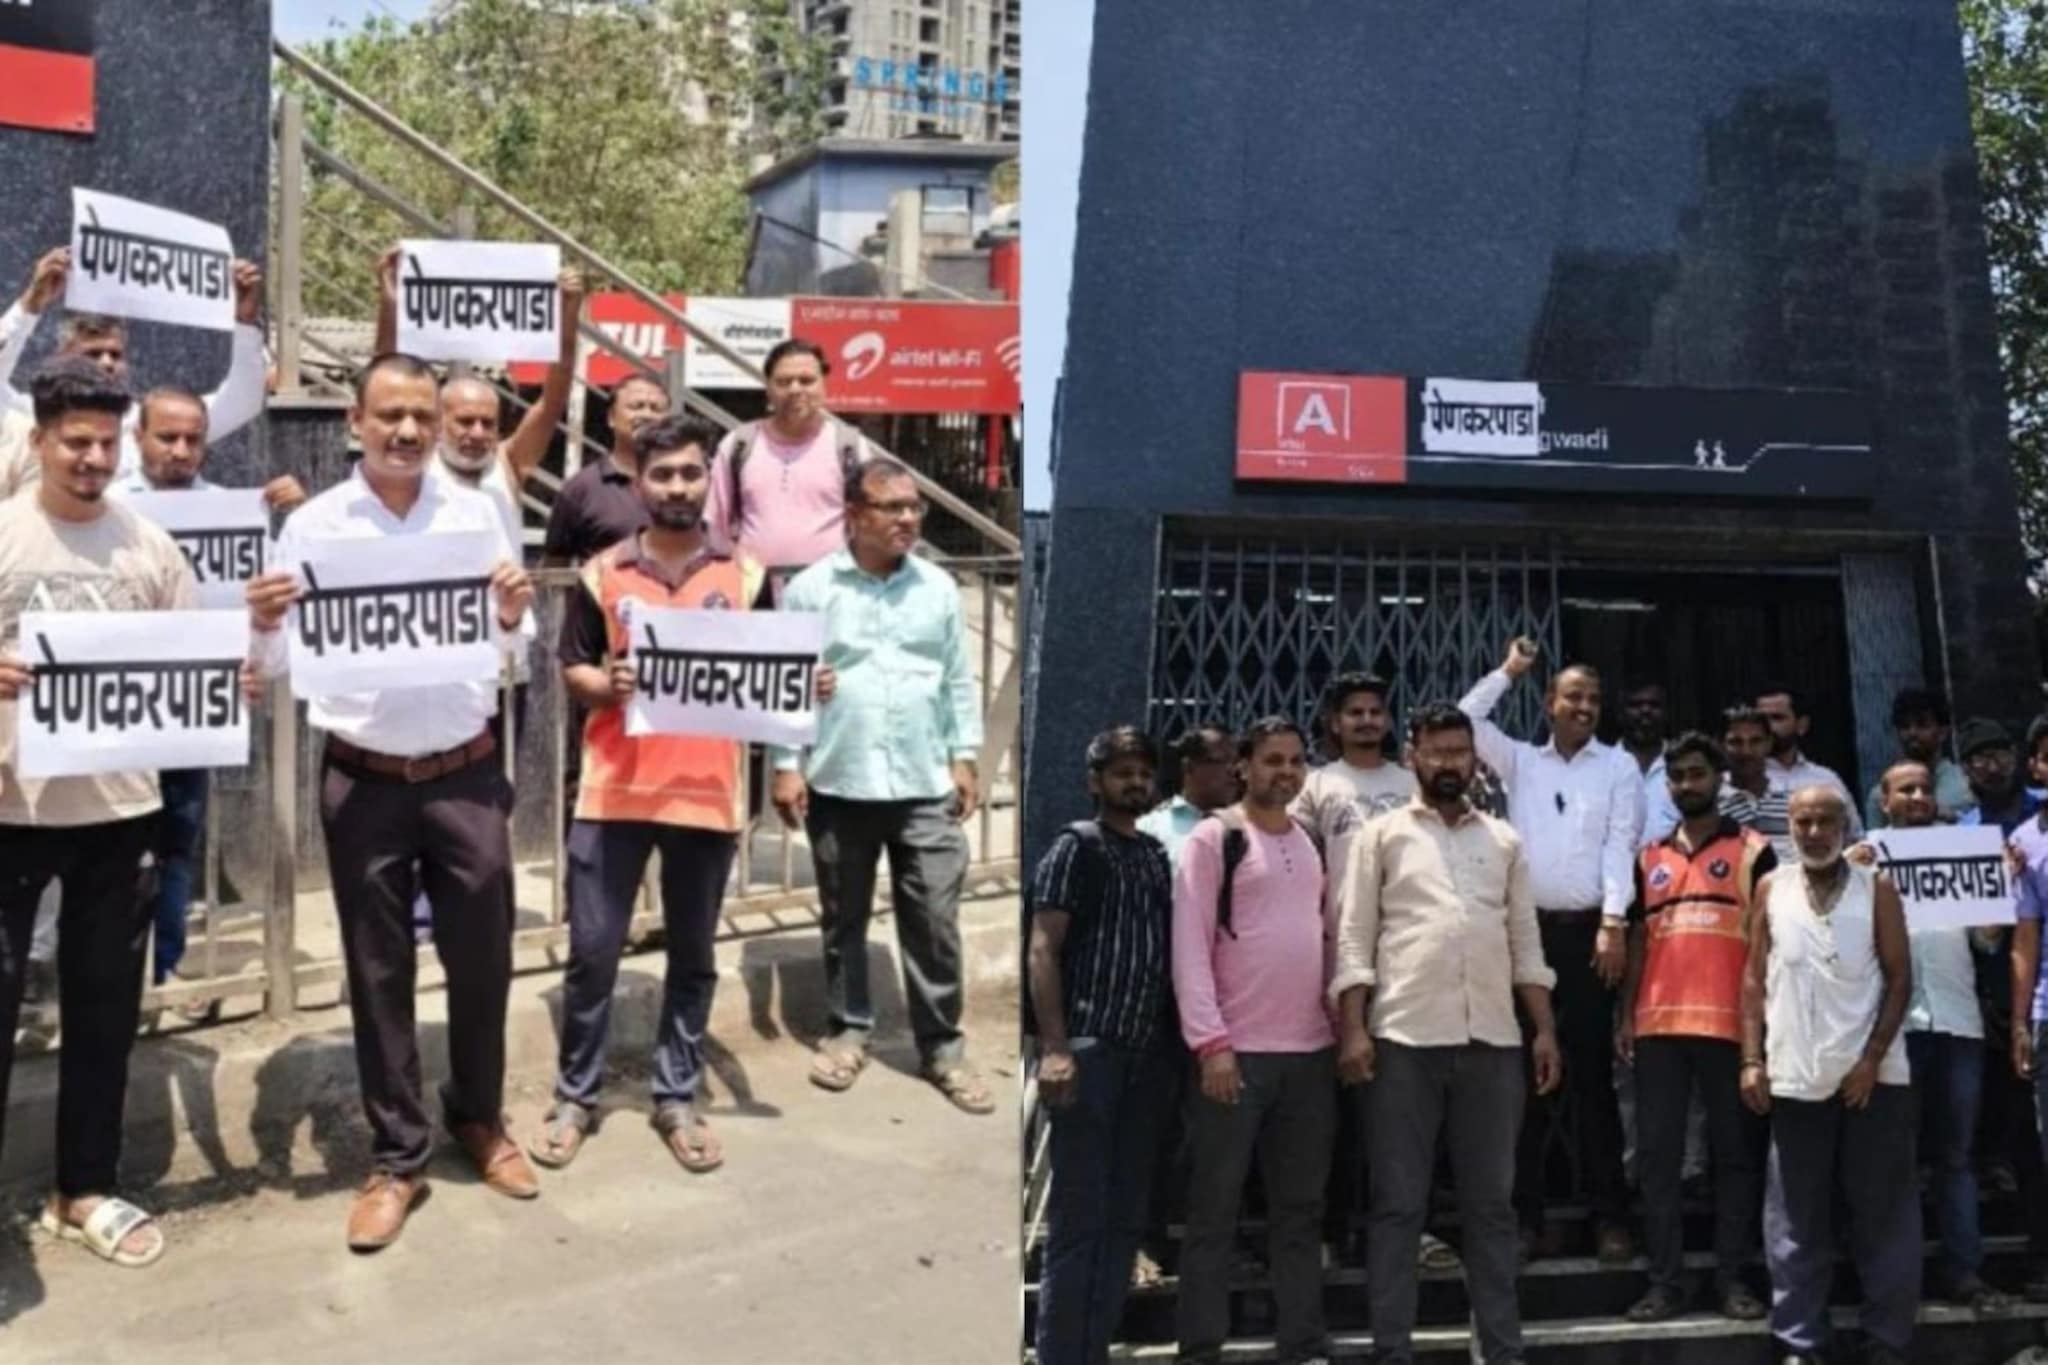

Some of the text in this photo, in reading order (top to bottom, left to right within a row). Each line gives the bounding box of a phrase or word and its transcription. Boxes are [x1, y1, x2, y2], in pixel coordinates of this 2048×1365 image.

[79, 203, 231, 301] पेणकरपाडा
[403, 254, 557, 332] पेणकरपाडा
[1293, 393, 1338, 436] A
[1428, 387, 1535, 437] पेणकरपाडा
[1539, 427, 1609, 452] gwadi
[299, 560, 490, 657] पेणकरपाडा
[31, 632, 245, 734] पेणकरपाडा
[635, 623, 818, 712] पेणकरपाडा
